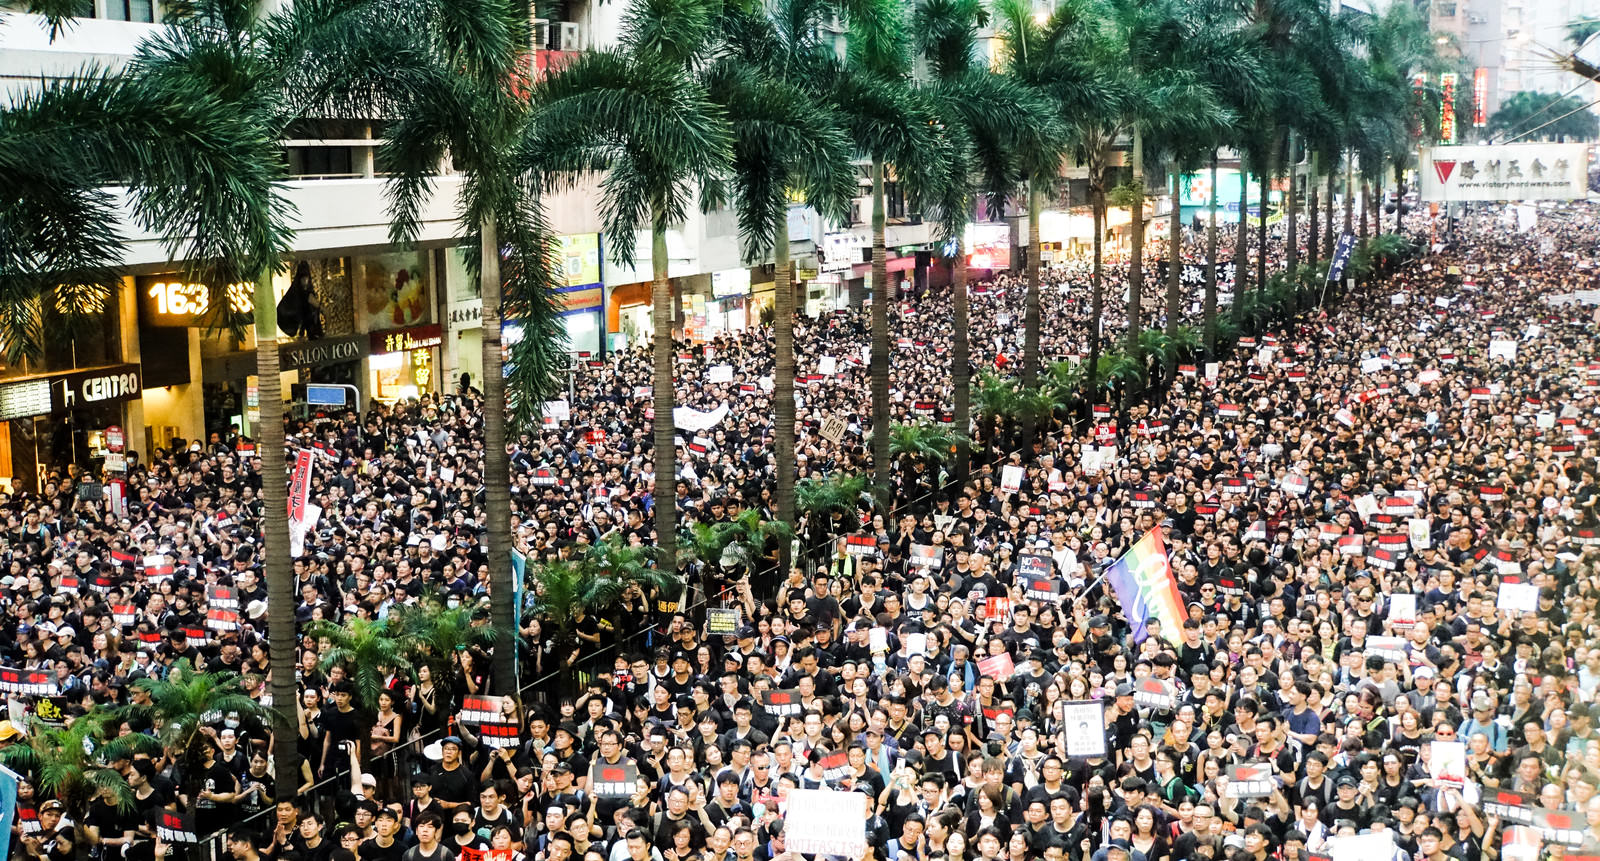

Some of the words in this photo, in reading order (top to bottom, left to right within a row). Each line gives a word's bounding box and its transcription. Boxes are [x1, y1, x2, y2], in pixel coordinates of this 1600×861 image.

[148, 282, 209, 316] 163
[291, 345, 328, 366] SALON
[332, 341, 359, 359] ICON
[385, 332, 413, 352] 許留山
[414, 348, 430, 395] 許留
[82, 372, 138, 402] CENTRO
